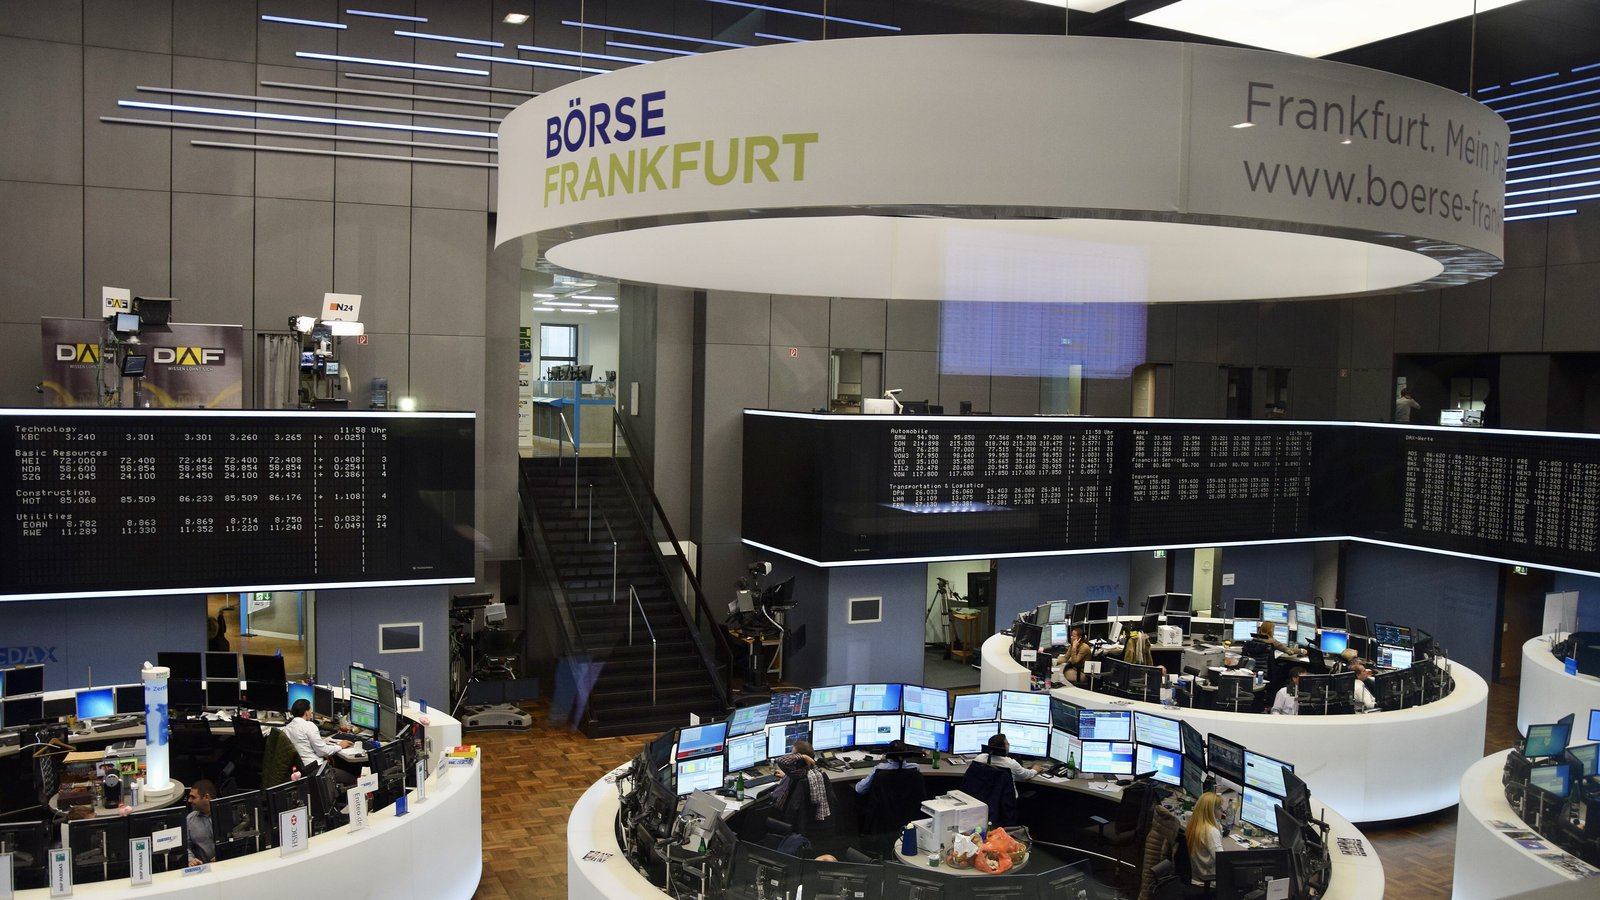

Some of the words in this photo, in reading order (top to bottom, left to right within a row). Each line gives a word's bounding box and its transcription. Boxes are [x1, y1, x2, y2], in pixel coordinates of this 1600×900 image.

[546, 90, 666, 159] BÖRSE
[1247, 81, 1434, 152] Frankfurt.
[1445, 119, 1489, 171] Mein
[544, 133, 819, 208] FRANKFURT
[154, 347, 224, 365] DAF
[334, 464, 362, 472] 0,254
[67, 520, 96, 528] 8,782
[127, 519, 156, 527] 8,863
[335, 516, 362, 524] 0,032
